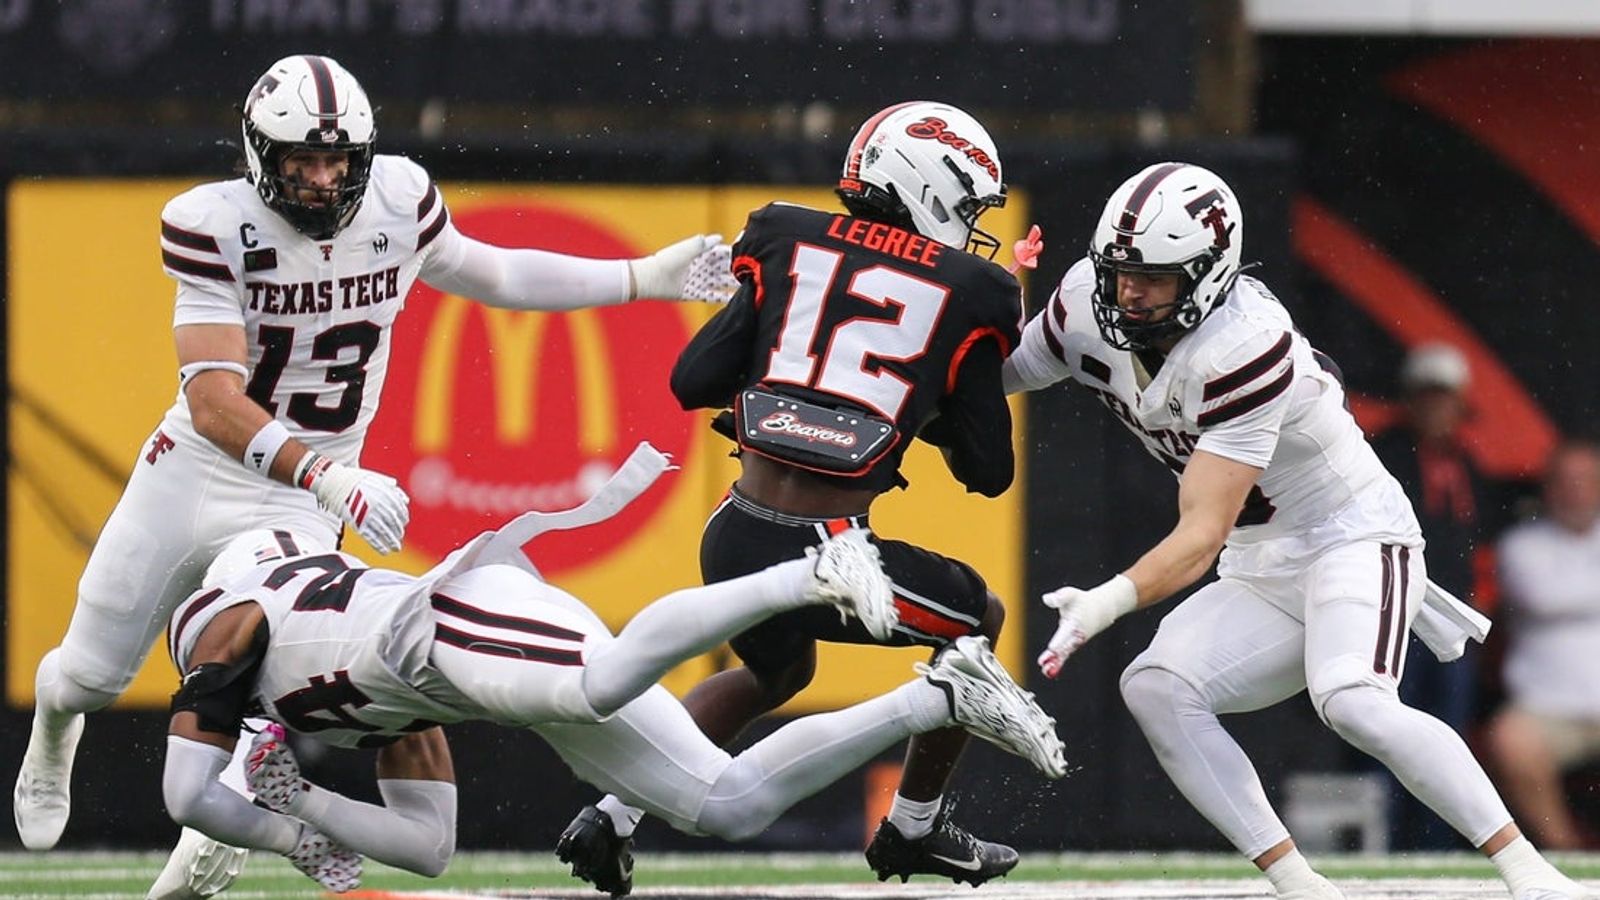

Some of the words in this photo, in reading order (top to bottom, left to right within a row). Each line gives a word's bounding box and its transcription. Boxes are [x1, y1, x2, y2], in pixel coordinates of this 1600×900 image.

[240, 222, 258, 249] C
[826, 215, 945, 268] LEGREE
[245, 281, 333, 315] TEXAS
[338, 265, 400, 310] TECH
[761, 241, 952, 424] 12
[245, 320, 382, 434] 13
[760, 411, 857, 447] Beavers
